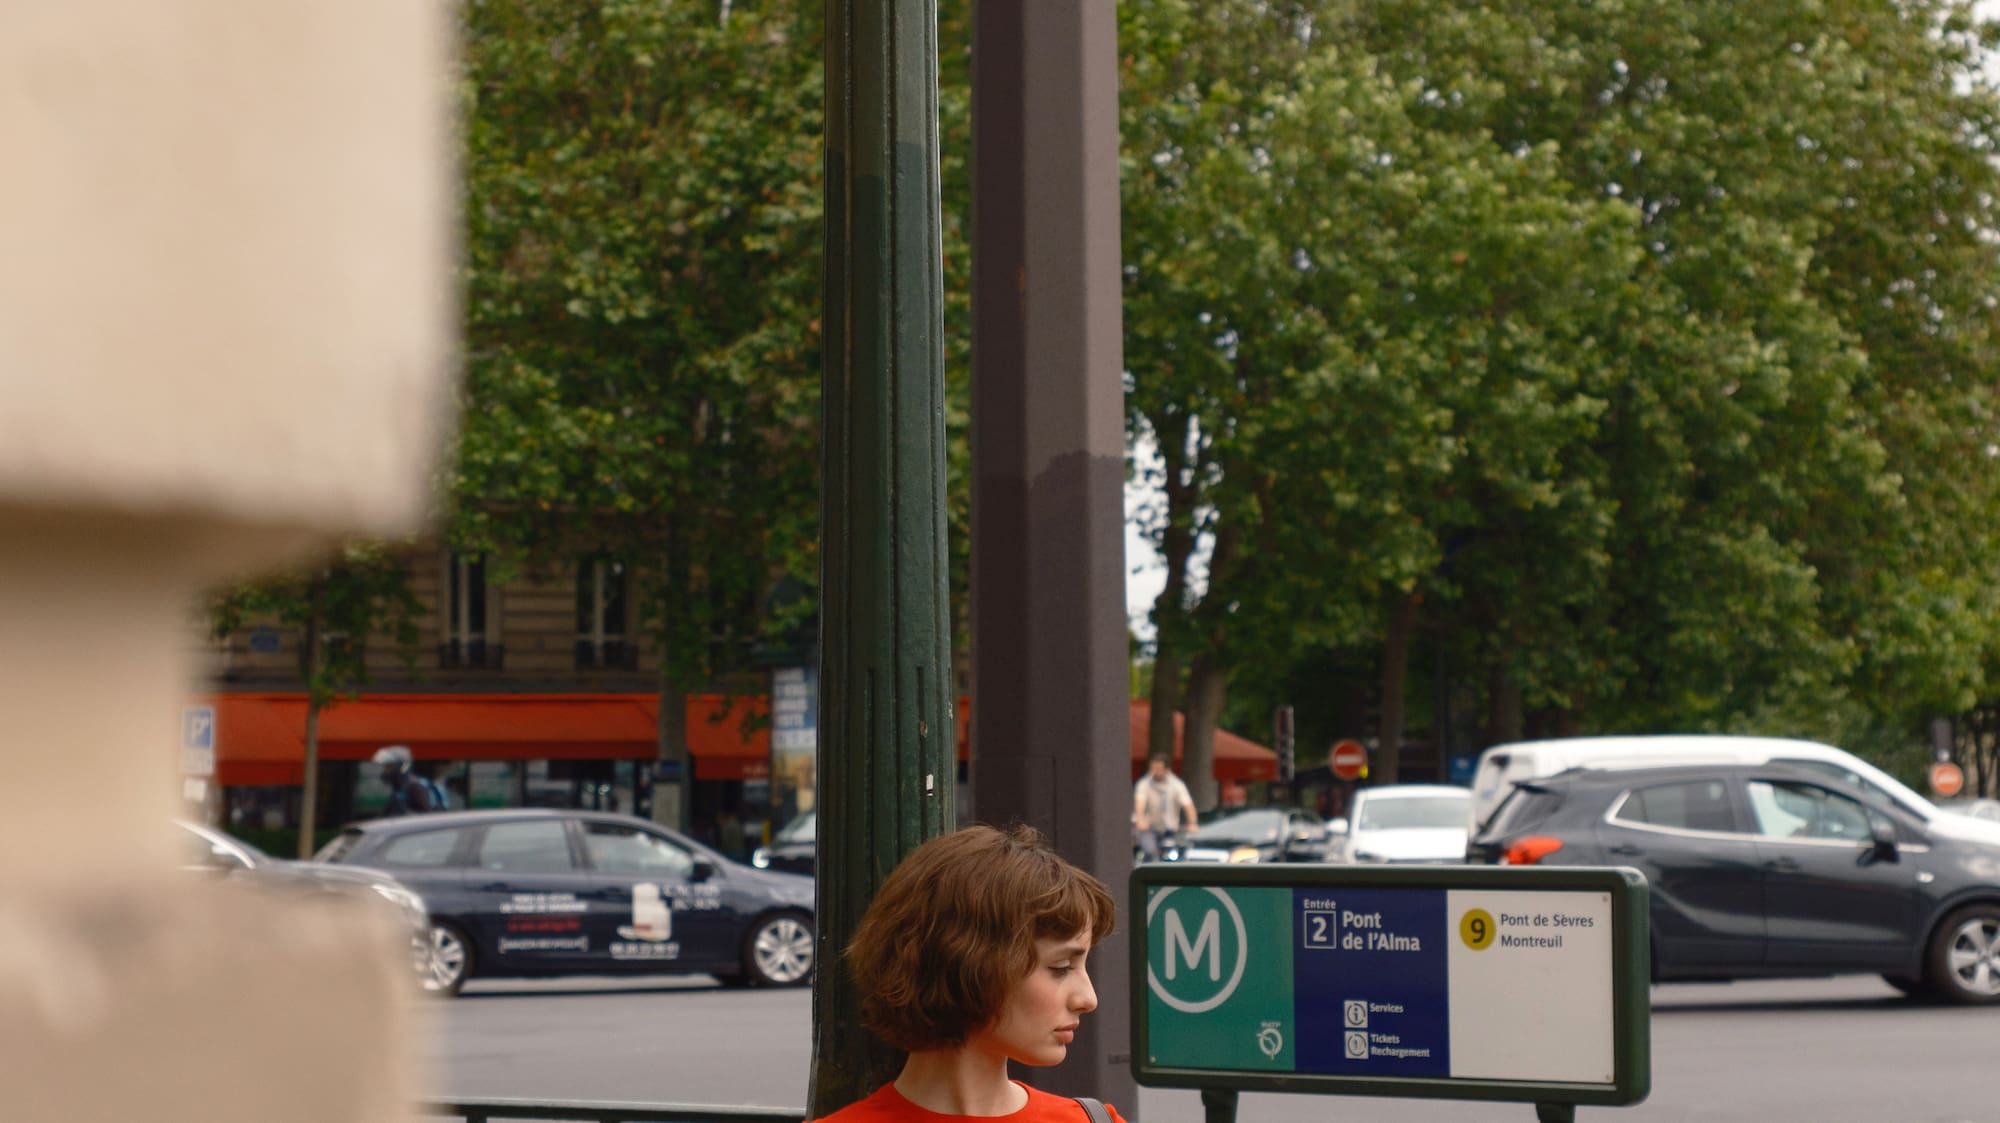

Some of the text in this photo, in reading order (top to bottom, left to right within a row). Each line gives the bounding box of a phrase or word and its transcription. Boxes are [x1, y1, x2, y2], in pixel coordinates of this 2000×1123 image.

[1303, 899, 1337, 910] Entrée
[1342, 911, 1382, 929] Pont
[1500, 913, 1594, 928] Pont de Sèvres
[1311, 916, 1328, 943] 2
[1470, 918, 1487, 944] 9
[1164, 908, 1221, 982] M
[1341, 933, 1421, 951] de l'Alma
[1501, 935, 1563, 948] Montreuil
[1369, 1002, 1404, 1014] Services
[1370, 1033, 1401, 1044] Tickets
[1371, 1046, 1431, 1058] Rechargement
